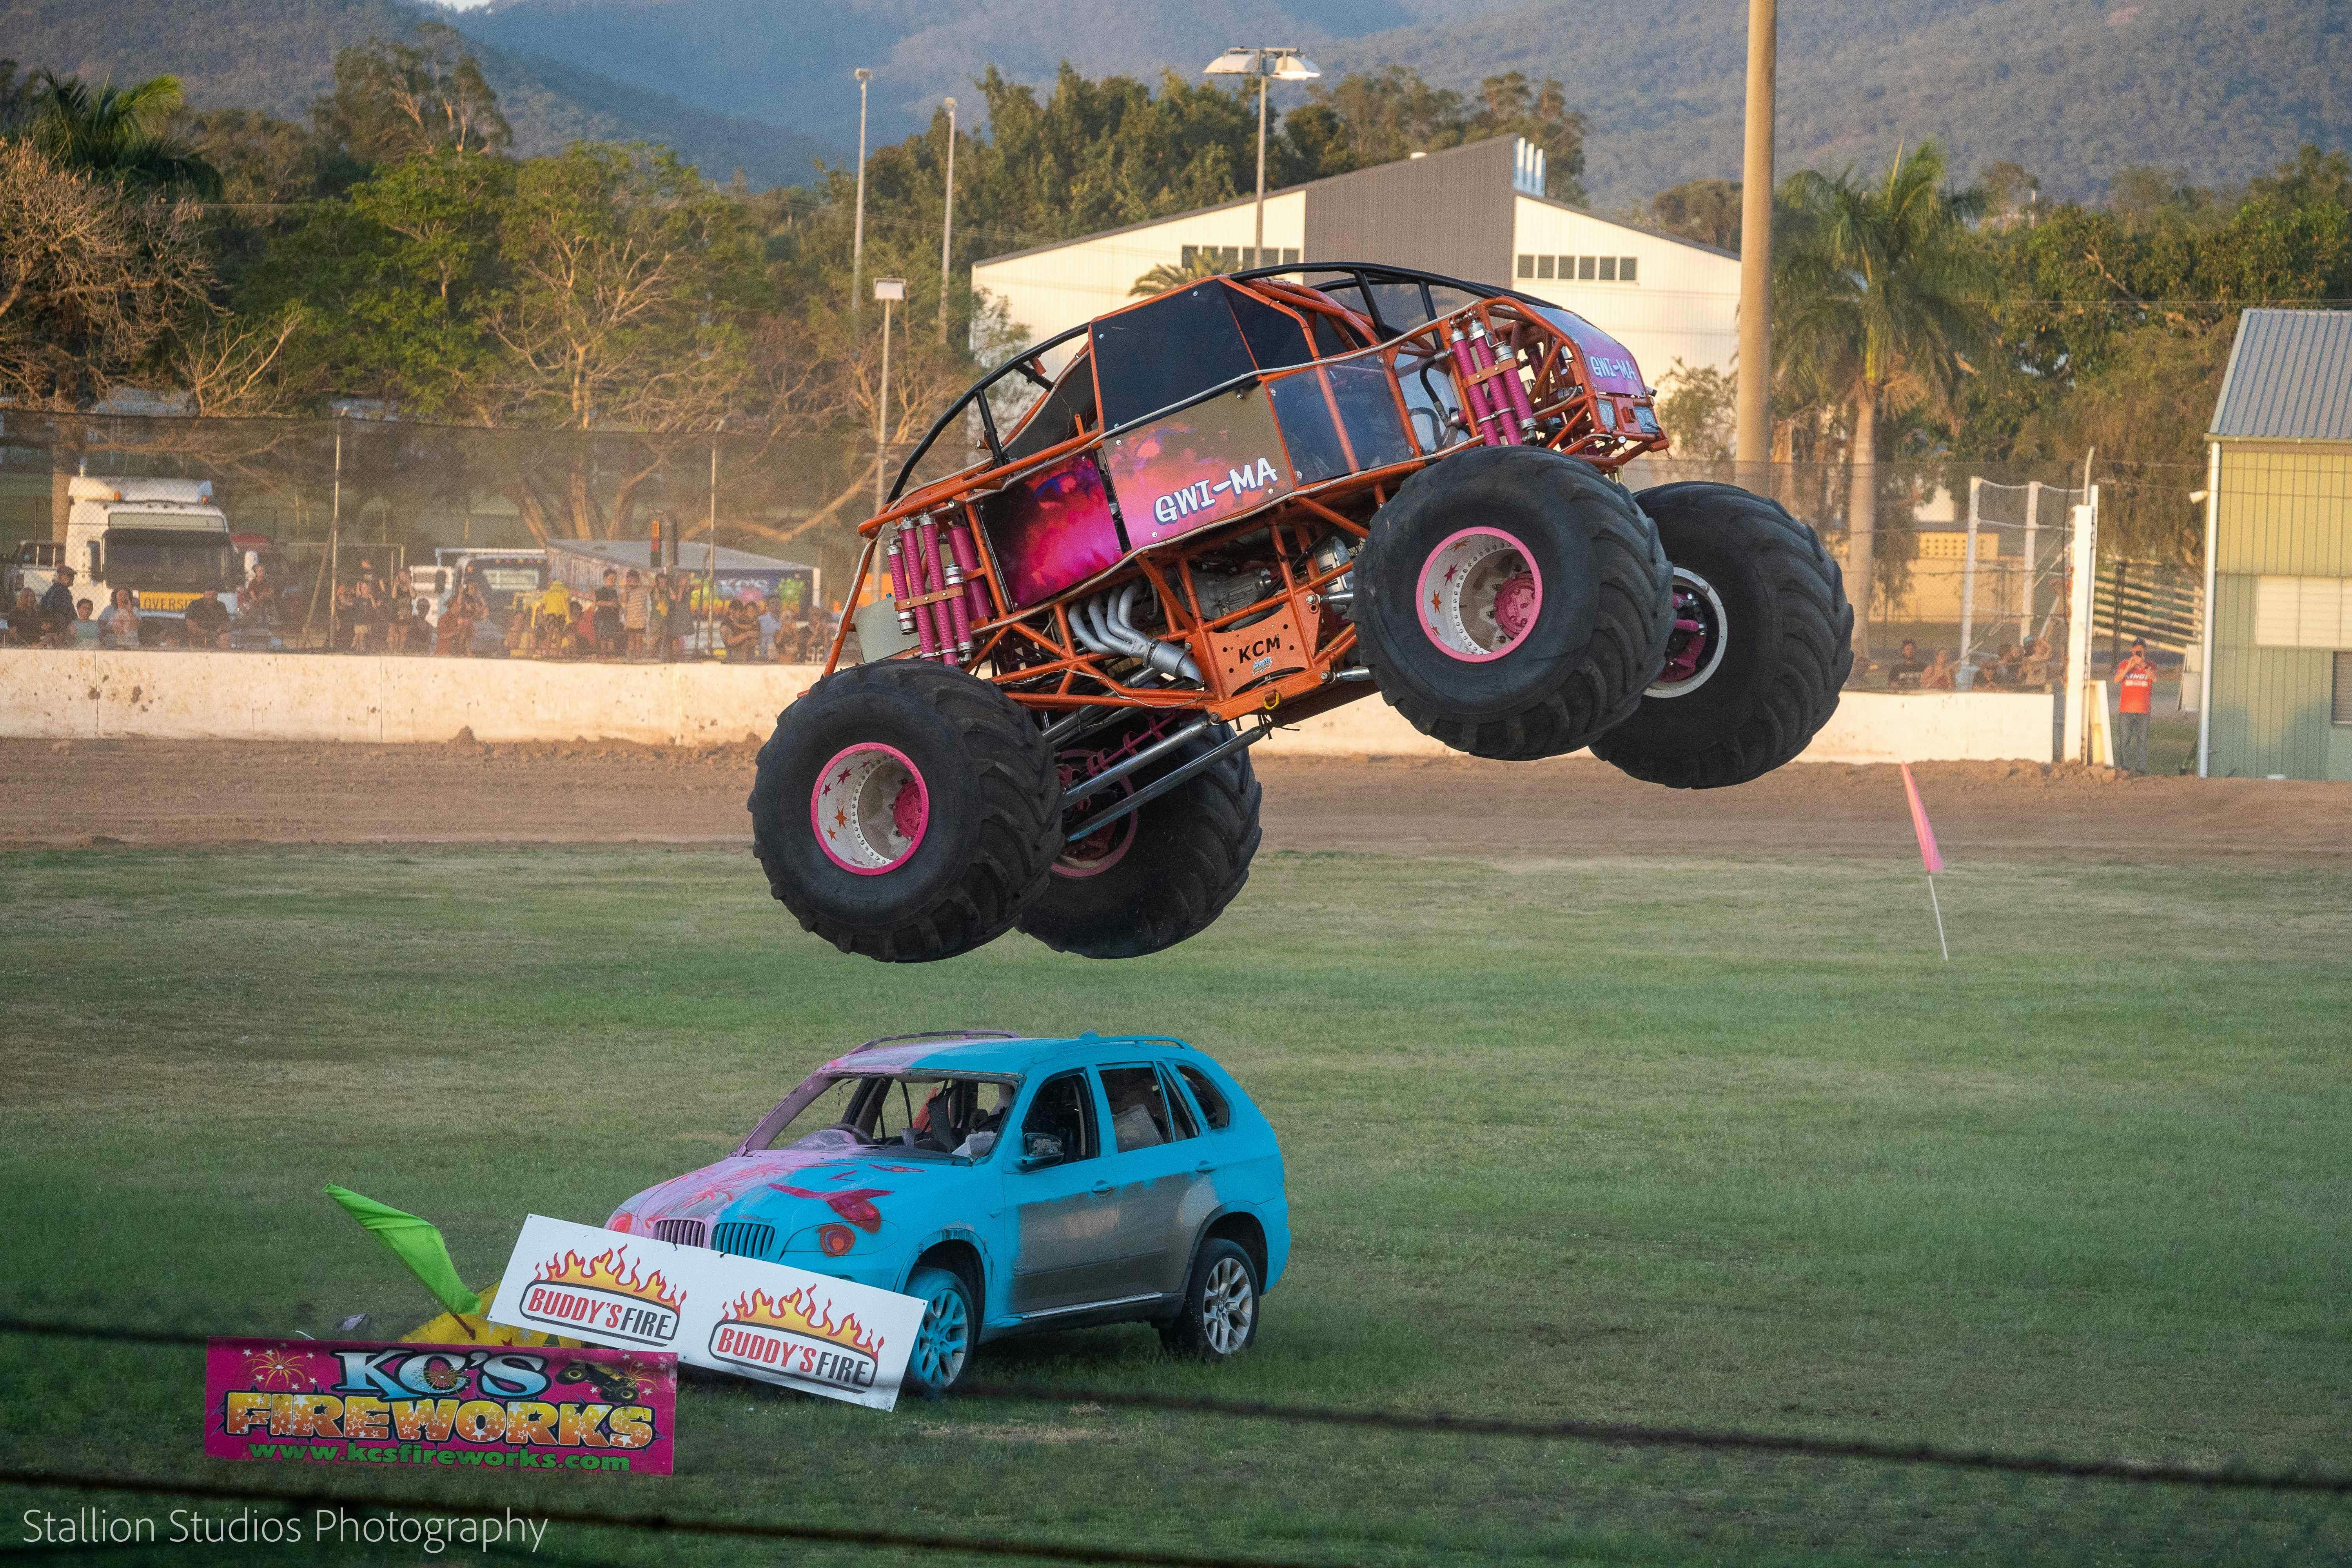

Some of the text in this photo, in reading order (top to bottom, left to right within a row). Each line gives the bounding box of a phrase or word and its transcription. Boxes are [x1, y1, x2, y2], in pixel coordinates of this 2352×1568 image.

[1590, 356, 1638, 381] GWI-MA
[1154, 457, 1278, 524] GWI-MA
[143, 596, 188, 610] OVERSI
[1239, 634, 1280, 664] KCM
[330, 1348, 551, 1401] KC'S
[225, 1390, 655, 1450] FIREWORKS
[248, 1443, 630, 1471] www.kcsfireworks.com
